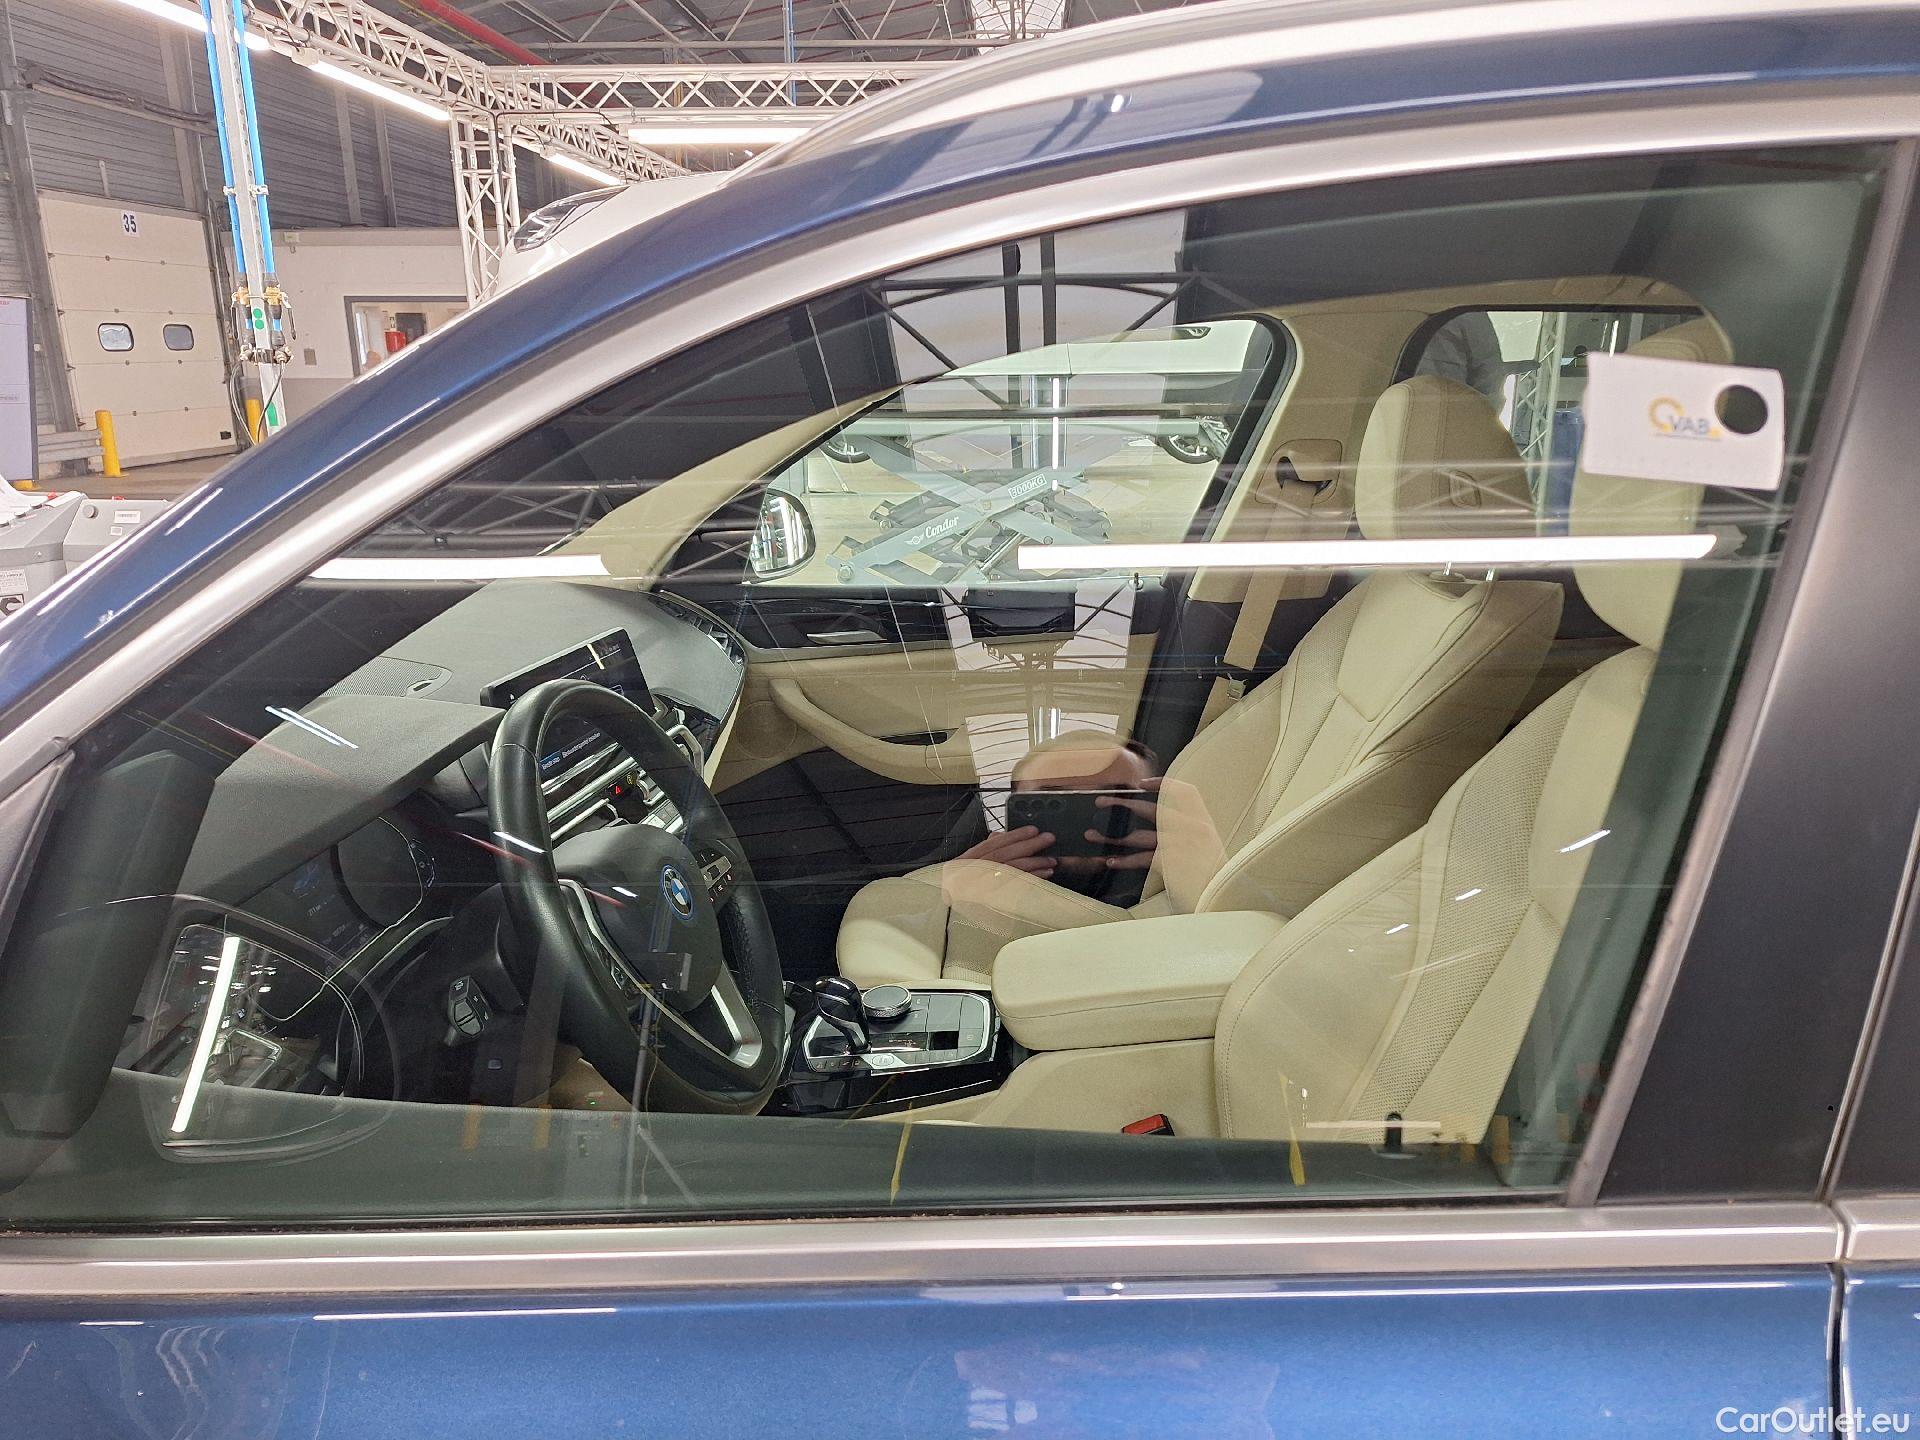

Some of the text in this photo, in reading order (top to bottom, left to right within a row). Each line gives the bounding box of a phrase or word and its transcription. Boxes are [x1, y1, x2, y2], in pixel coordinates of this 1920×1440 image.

[123, 213, 137, 233] 35
[1010, 475, 1045, 498] 3000KG
[925, 516, 959, 539] Condor
